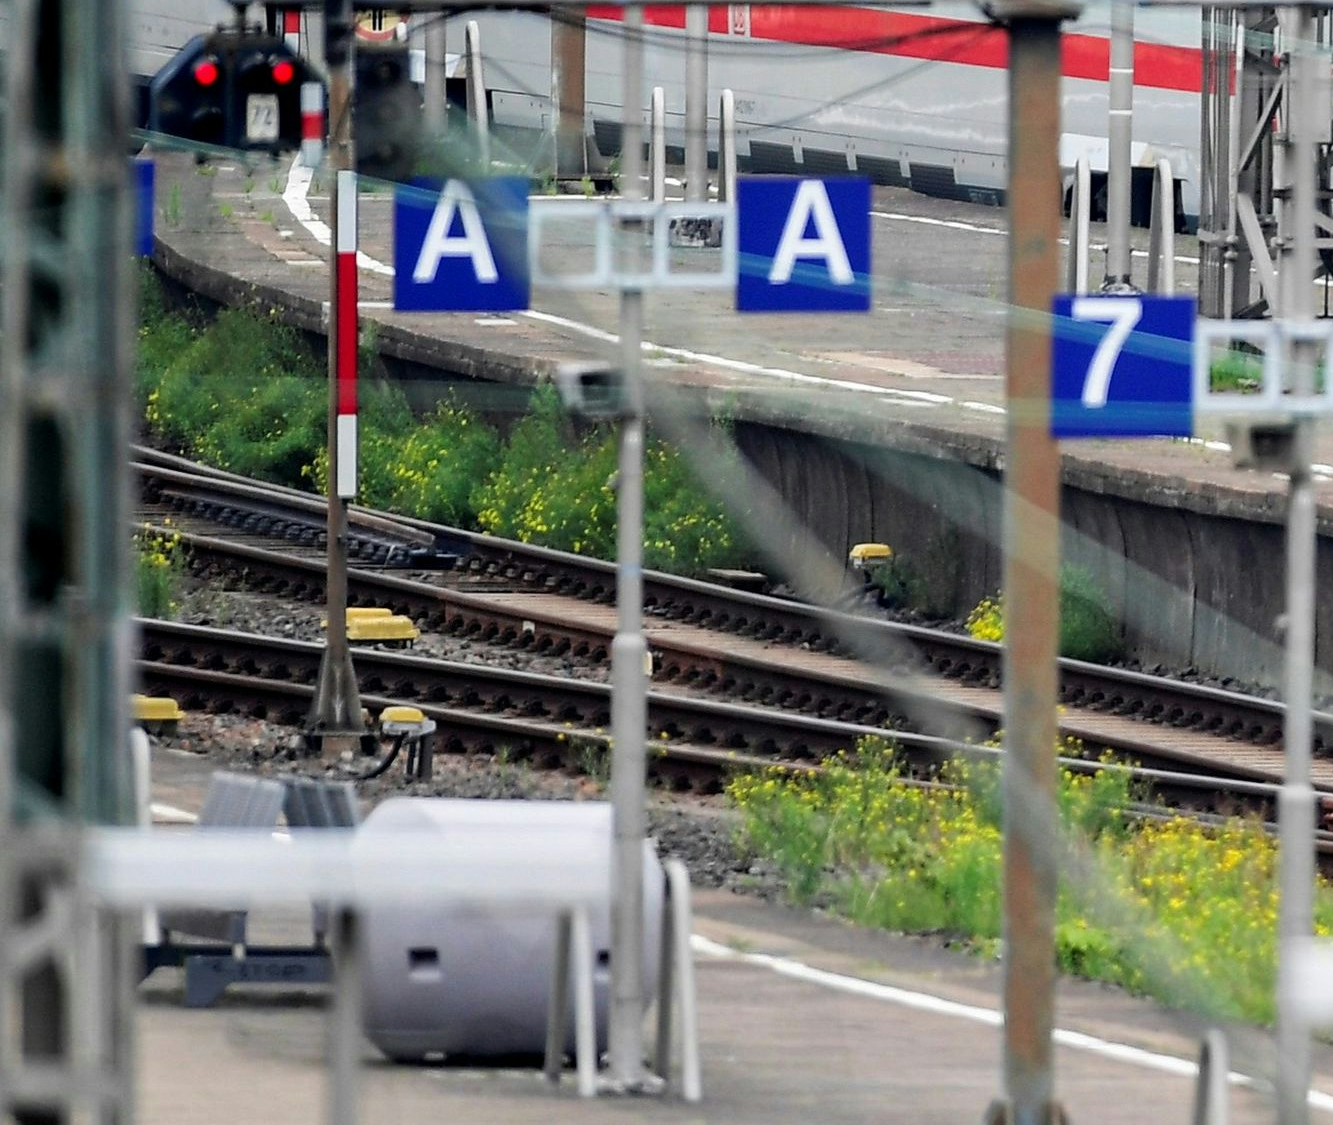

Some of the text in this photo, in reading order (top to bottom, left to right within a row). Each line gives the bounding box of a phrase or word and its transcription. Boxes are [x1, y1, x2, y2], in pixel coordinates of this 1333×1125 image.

[411, 178, 499, 284] A
[767, 178, 855, 286] A
[1071, 298, 1142, 409] 7
